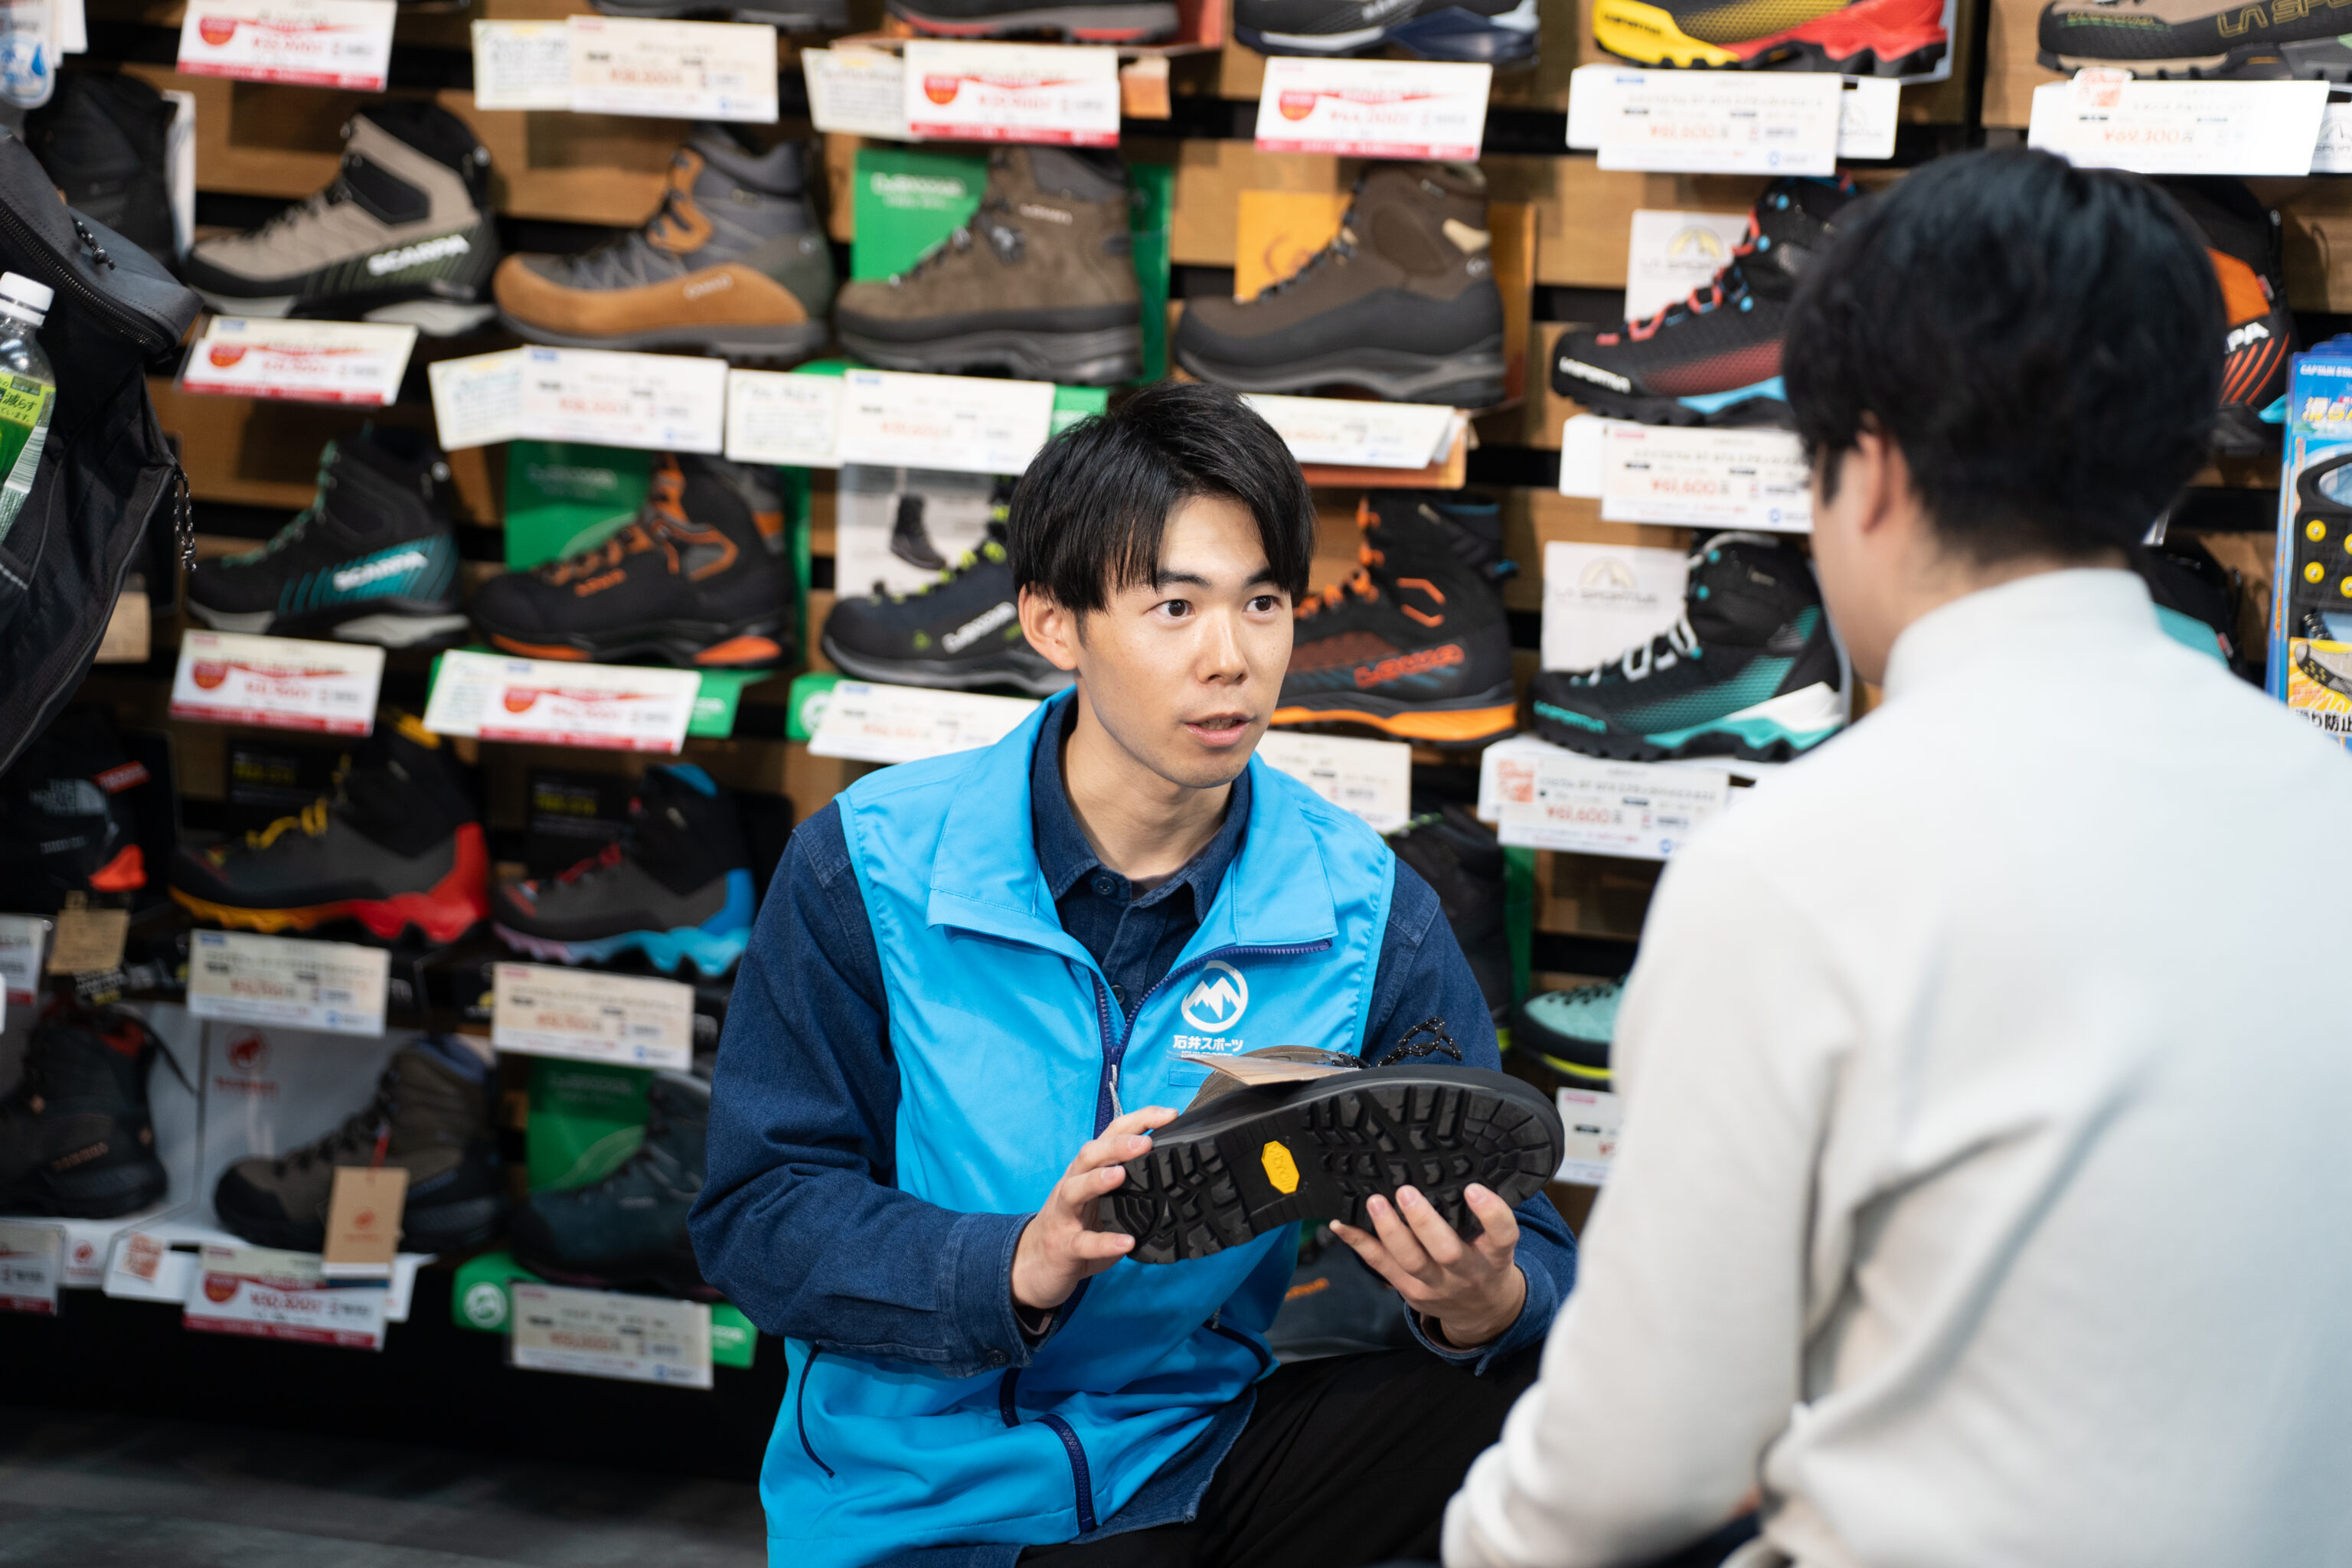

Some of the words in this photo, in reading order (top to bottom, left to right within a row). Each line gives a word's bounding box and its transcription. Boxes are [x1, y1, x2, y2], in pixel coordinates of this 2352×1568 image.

[2217, 5, 2269, 38] LA
[368, 234, 471, 276] SCARPA
[1354, 643, 1465, 689] LOWA
[2295, 709, 2352, 733] り防止
[1172, 1034, 1244, 1053] 石井スポーツ
